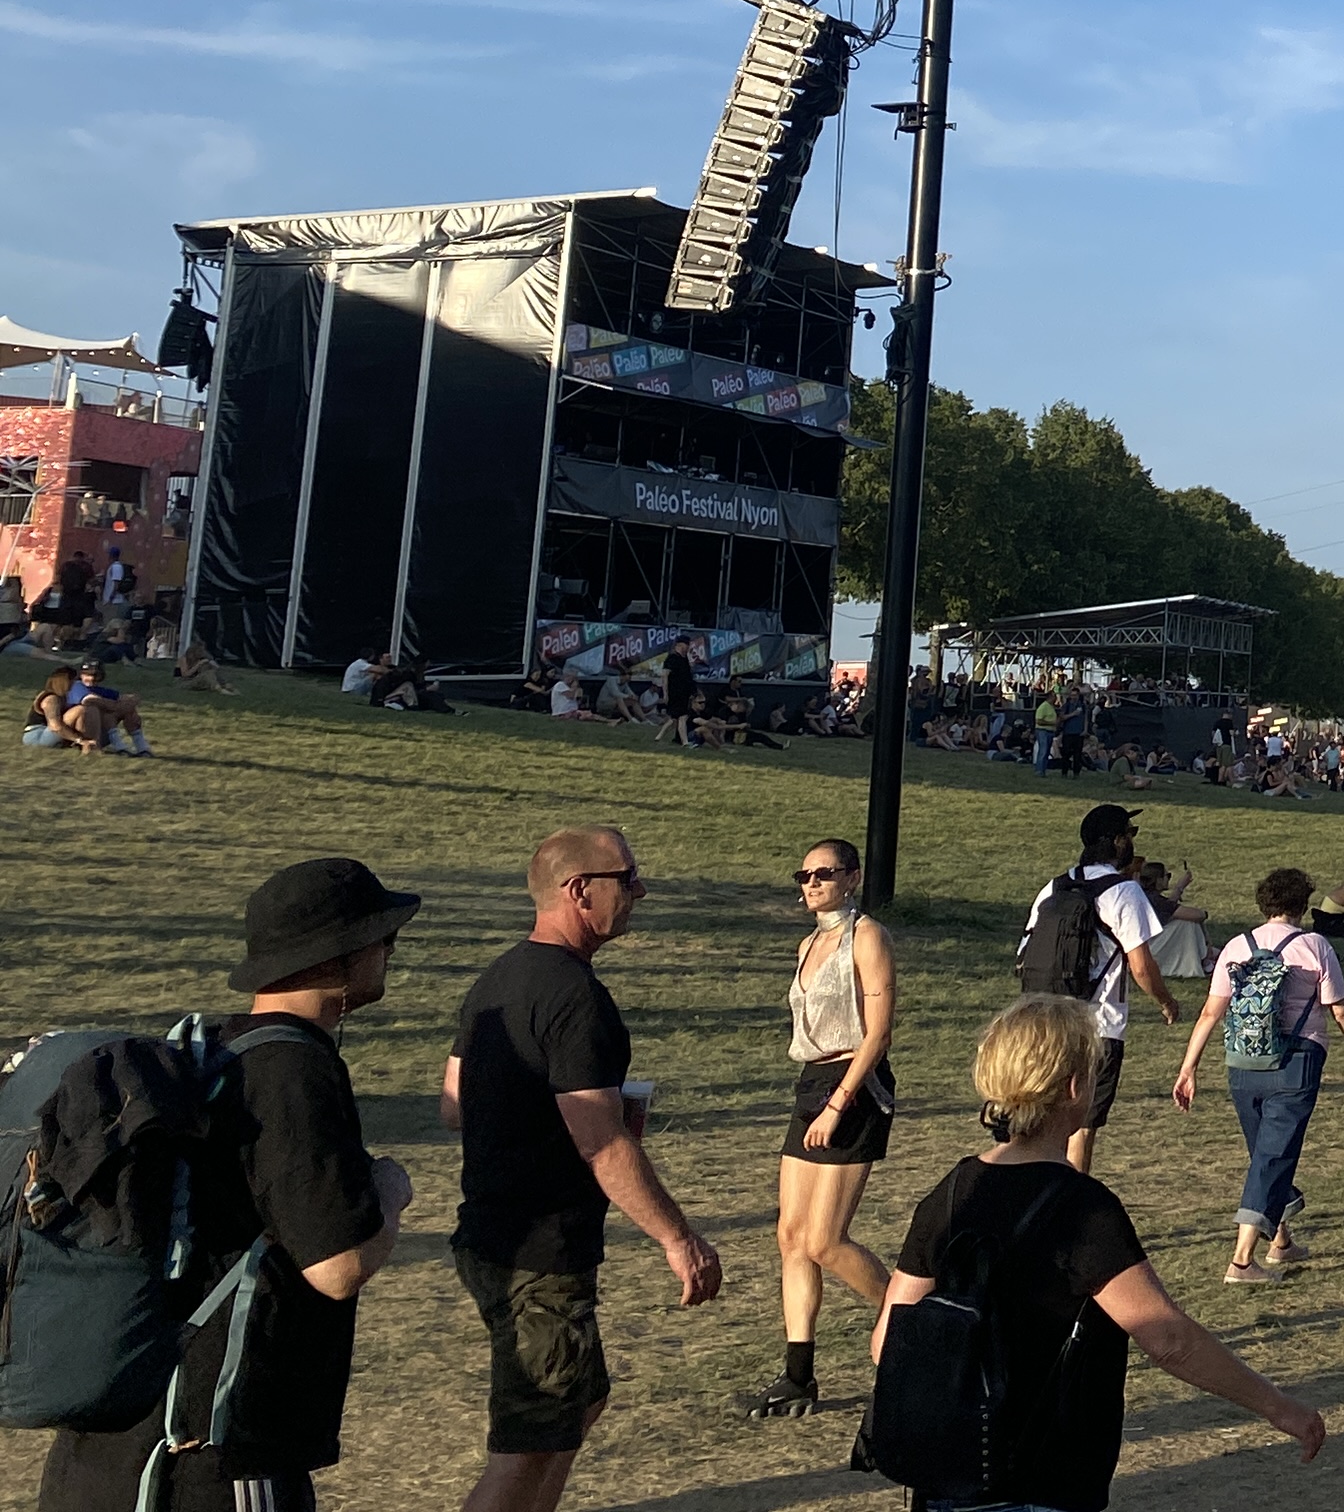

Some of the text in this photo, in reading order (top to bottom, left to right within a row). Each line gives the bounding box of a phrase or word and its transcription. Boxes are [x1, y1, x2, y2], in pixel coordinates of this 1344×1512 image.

[572, 357, 610, 379] Paléo
[613, 349, 647, 375] Paléo
[711, 374, 744, 398] Paléo
[766, 390, 798, 413] Paléo
[635, 482, 778, 530] Paléo Festival Nyon
[541, 628, 579, 658] Paléo
[608, 635, 643, 665] Paléo
